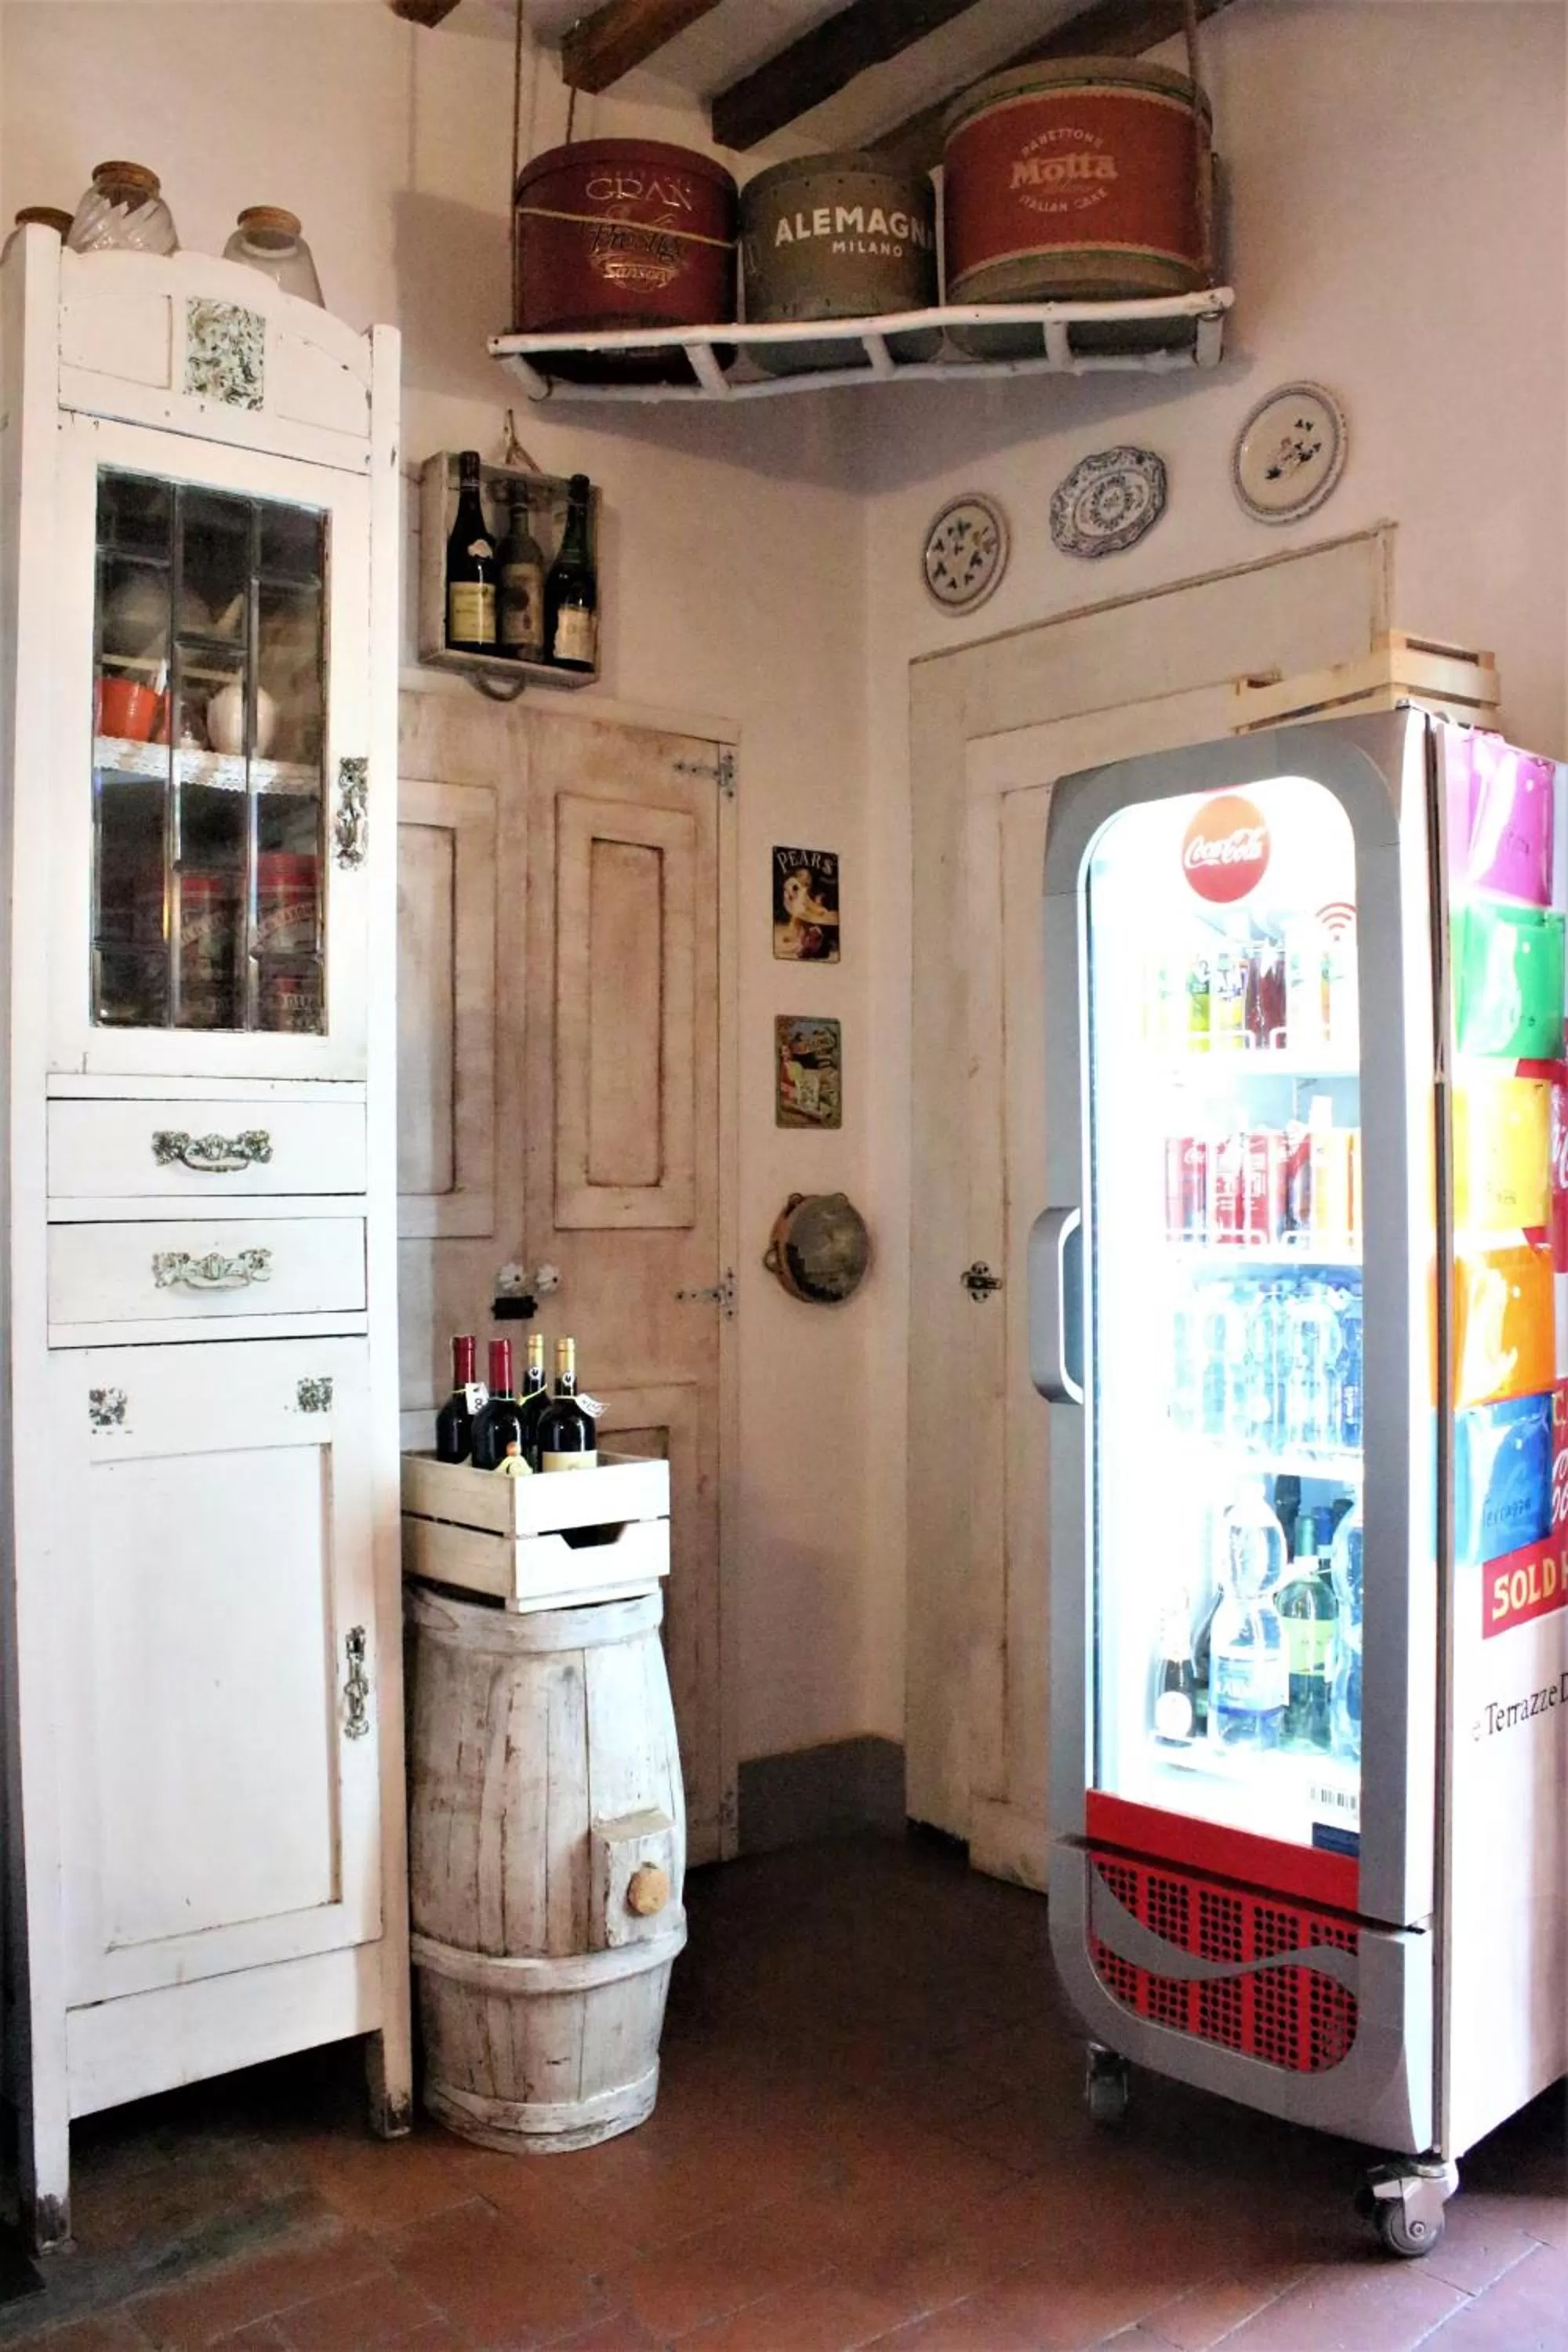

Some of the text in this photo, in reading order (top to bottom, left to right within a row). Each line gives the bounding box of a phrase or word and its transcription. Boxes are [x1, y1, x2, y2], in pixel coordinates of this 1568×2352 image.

[1009, 152, 1119, 189] Motta
[832, 240, 903, 258] MILANO
[776, 850, 833, 876] PEARS
[1492, 1557, 1556, 1622] SOLD
